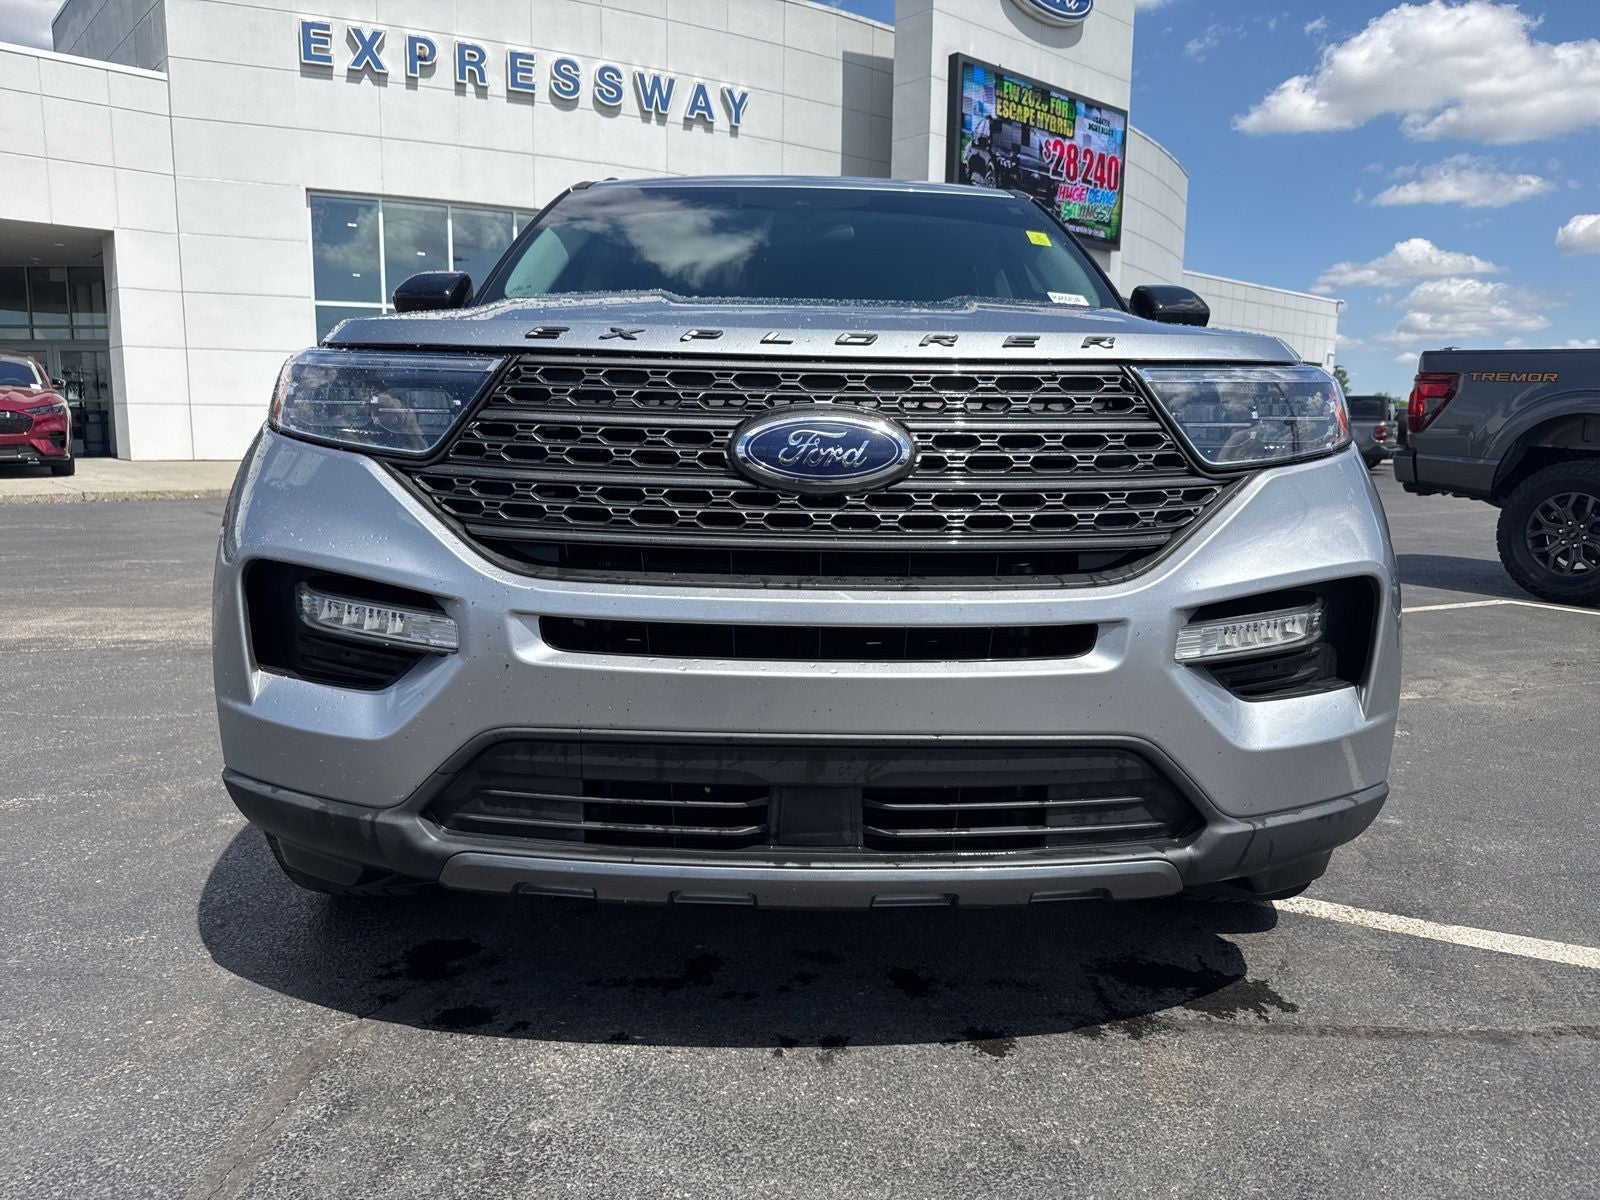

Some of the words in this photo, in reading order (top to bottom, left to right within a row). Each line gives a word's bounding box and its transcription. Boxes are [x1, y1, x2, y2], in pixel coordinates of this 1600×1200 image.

[299, 19, 750, 127] EXPRESSWAY
[996, 98, 1036, 126] ESCAPE
[1036, 111, 1075, 138] HYBRID
[1049, 96, 1076, 120] FORD
[1057, 184, 1087, 203] HUGE
[1087, 187, 1117, 207] DEMO
[524, 325, 1117, 350] EXPLORER
[1470, 372, 1559, 382] TREMOR
[778, 429, 870, 467] Ford
